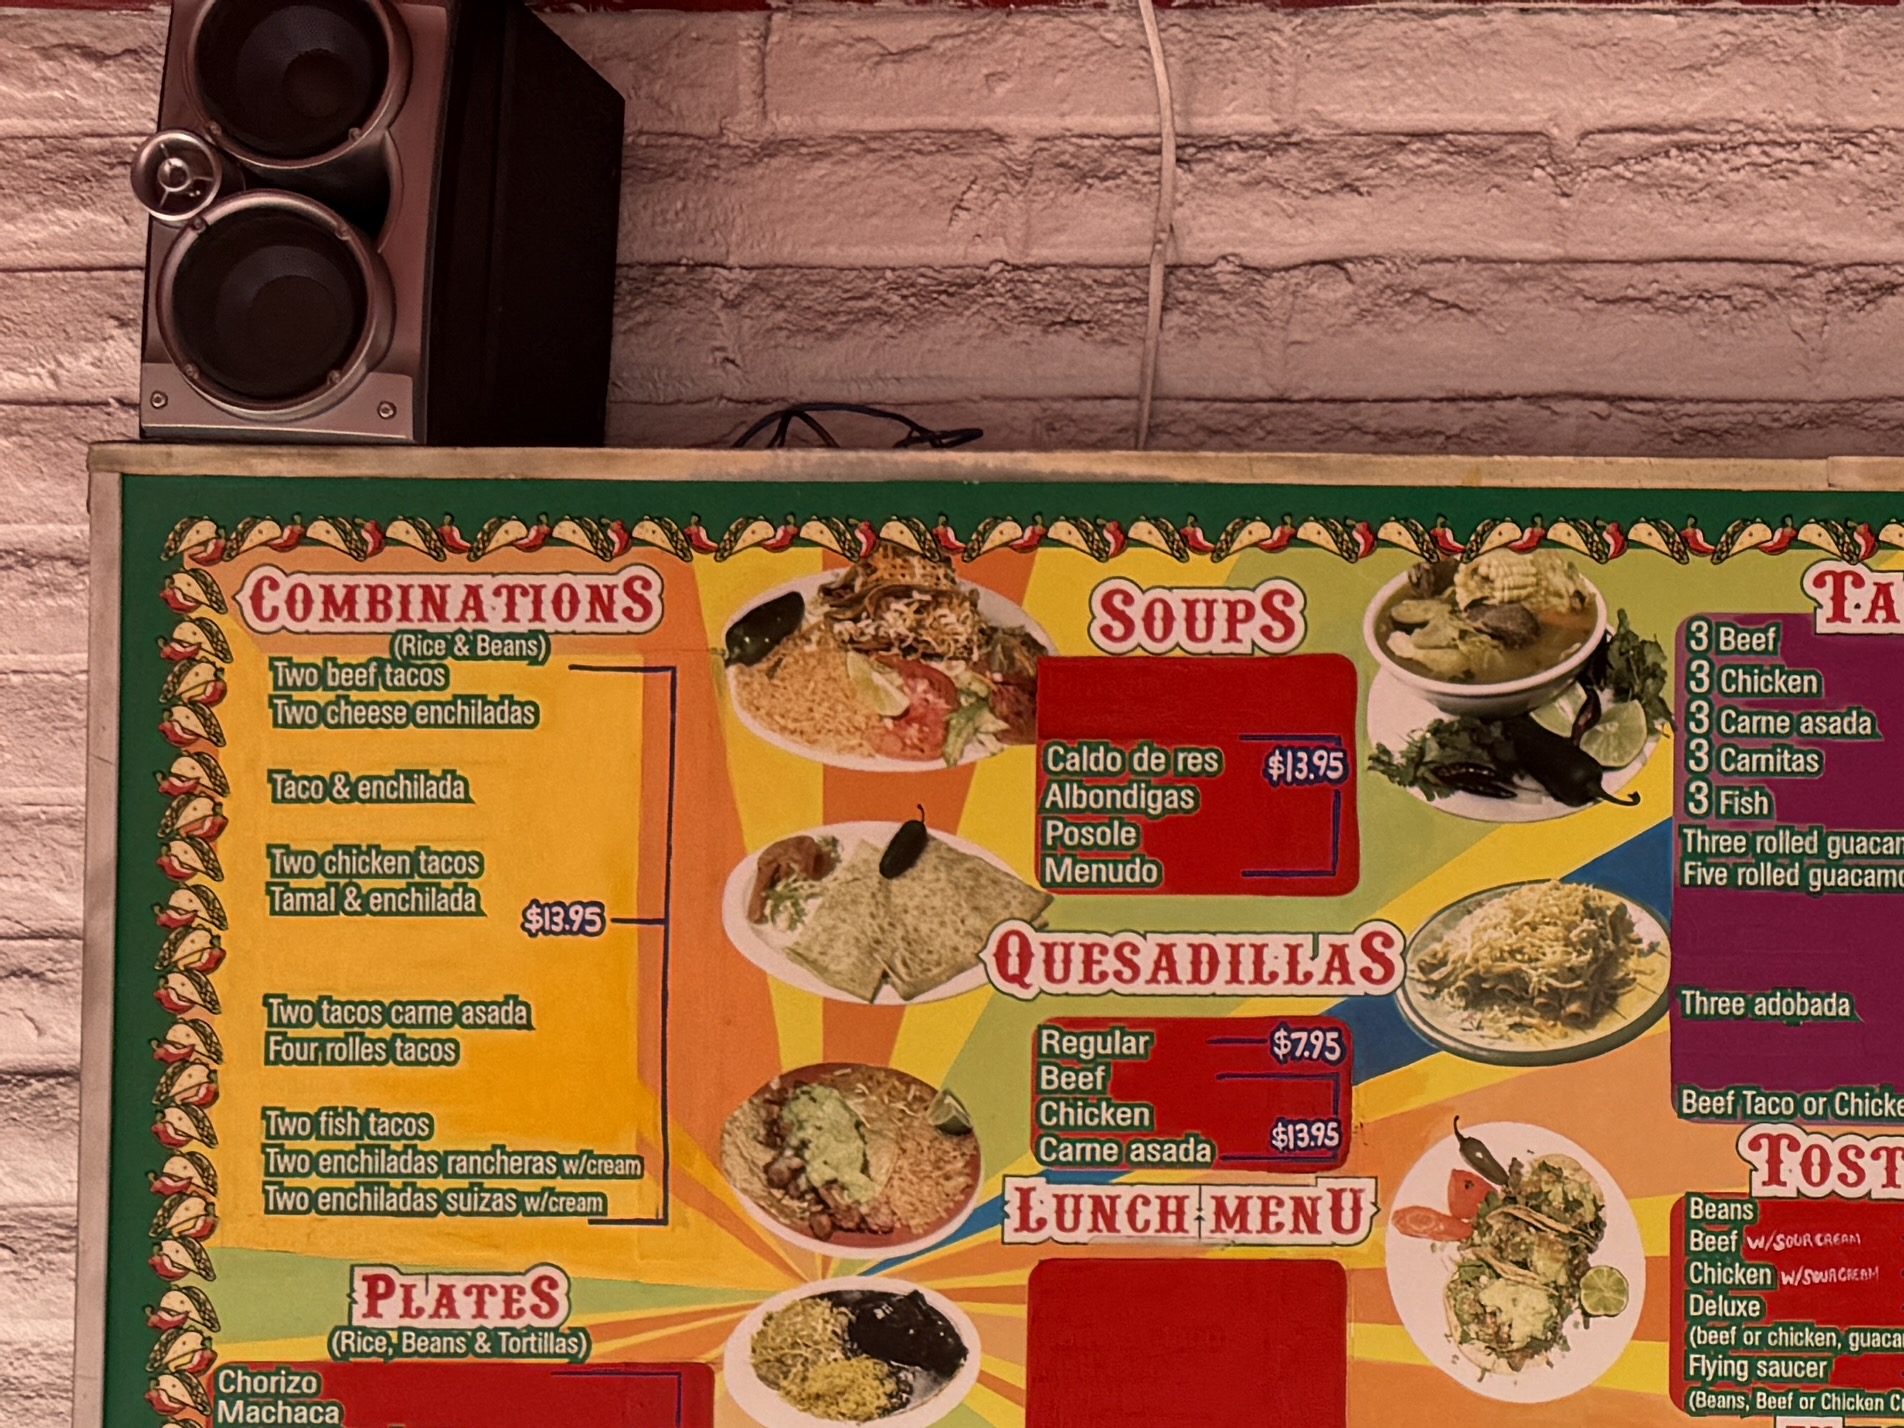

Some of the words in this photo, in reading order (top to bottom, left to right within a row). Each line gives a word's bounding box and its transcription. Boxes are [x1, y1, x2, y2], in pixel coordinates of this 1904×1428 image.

[248, 574, 655, 622] COMBINATIONS
[1101, 588, 1296, 643] SOUPS
[275, 662, 319, 686] Two
[326, 662, 379, 686] beef
[385, 666, 445, 686] tacos
[1691, 661, 1710, 693] 3
[1722, 669, 1817, 694] Chicken
[1268, 751, 1343, 781] $13.95
[1046, 785, 1194, 815] Albondigas
[1045, 858, 1157, 883] Menudo
[524, 903, 601, 934] $13.95
[994, 926, 1396, 988] QUESADILLAS
[1683, 992, 1744, 1015] Three
[1755, 991, 1849, 1016] adobada
[1041, 1031, 1148, 1058] Regular
[1274, 1028, 1340, 1062] $7.95
[1040, 1102, 1149, 1128] Chicken
[1015, 1187, 1186, 1234] LUNCH
[1209, 1187, 1363, 1234] MENU
[360, 1274, 561, 1319] PLATES
[1690, 1357, 1748, 1381] Flying
[1757, 1360, 1827, 1378] saucer
[218, 1401, 339, 1424] Machaca
